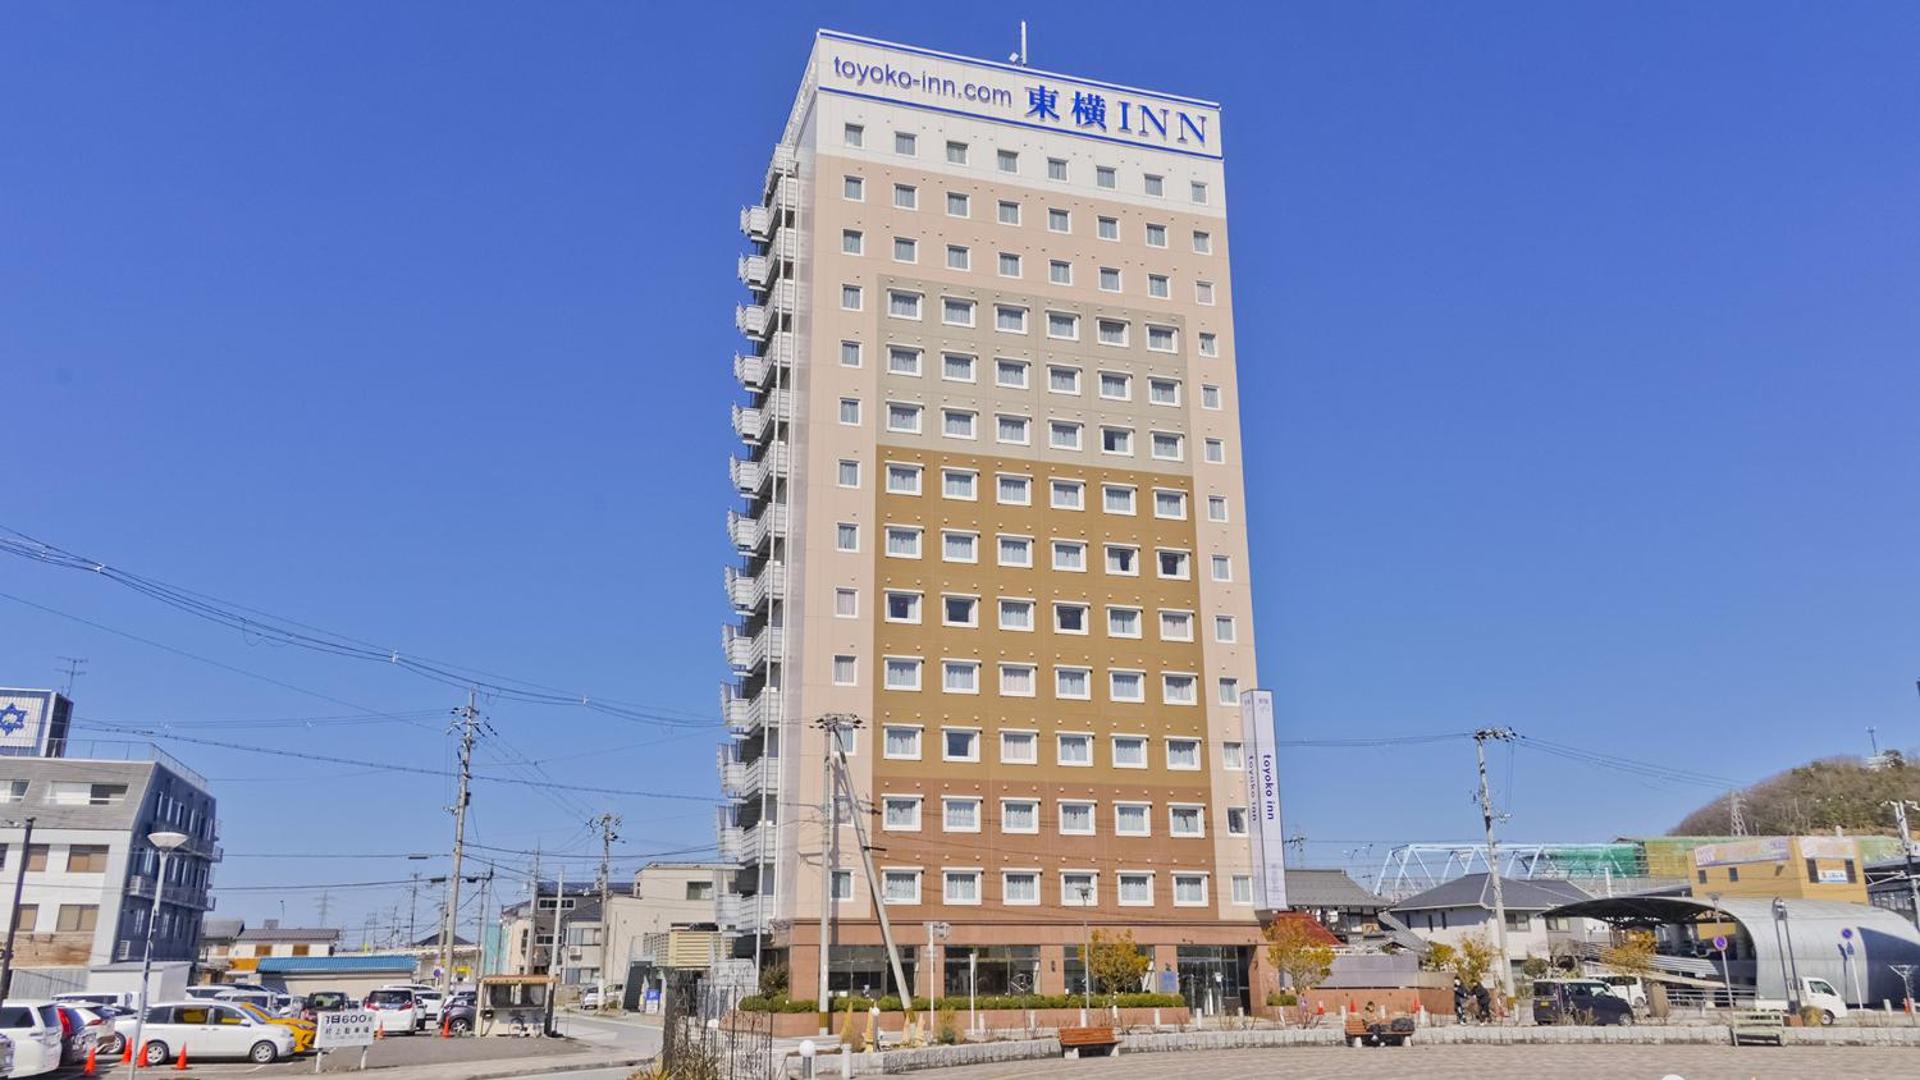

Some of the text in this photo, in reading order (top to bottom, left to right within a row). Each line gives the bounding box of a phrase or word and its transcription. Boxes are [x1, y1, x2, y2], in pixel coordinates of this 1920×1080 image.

[834, 56, 1012, 107] toyoko-inn.com
[1024, 85, 1207, 146] 東横INN
[1262, 754, 1275, 820] toyoko inn
